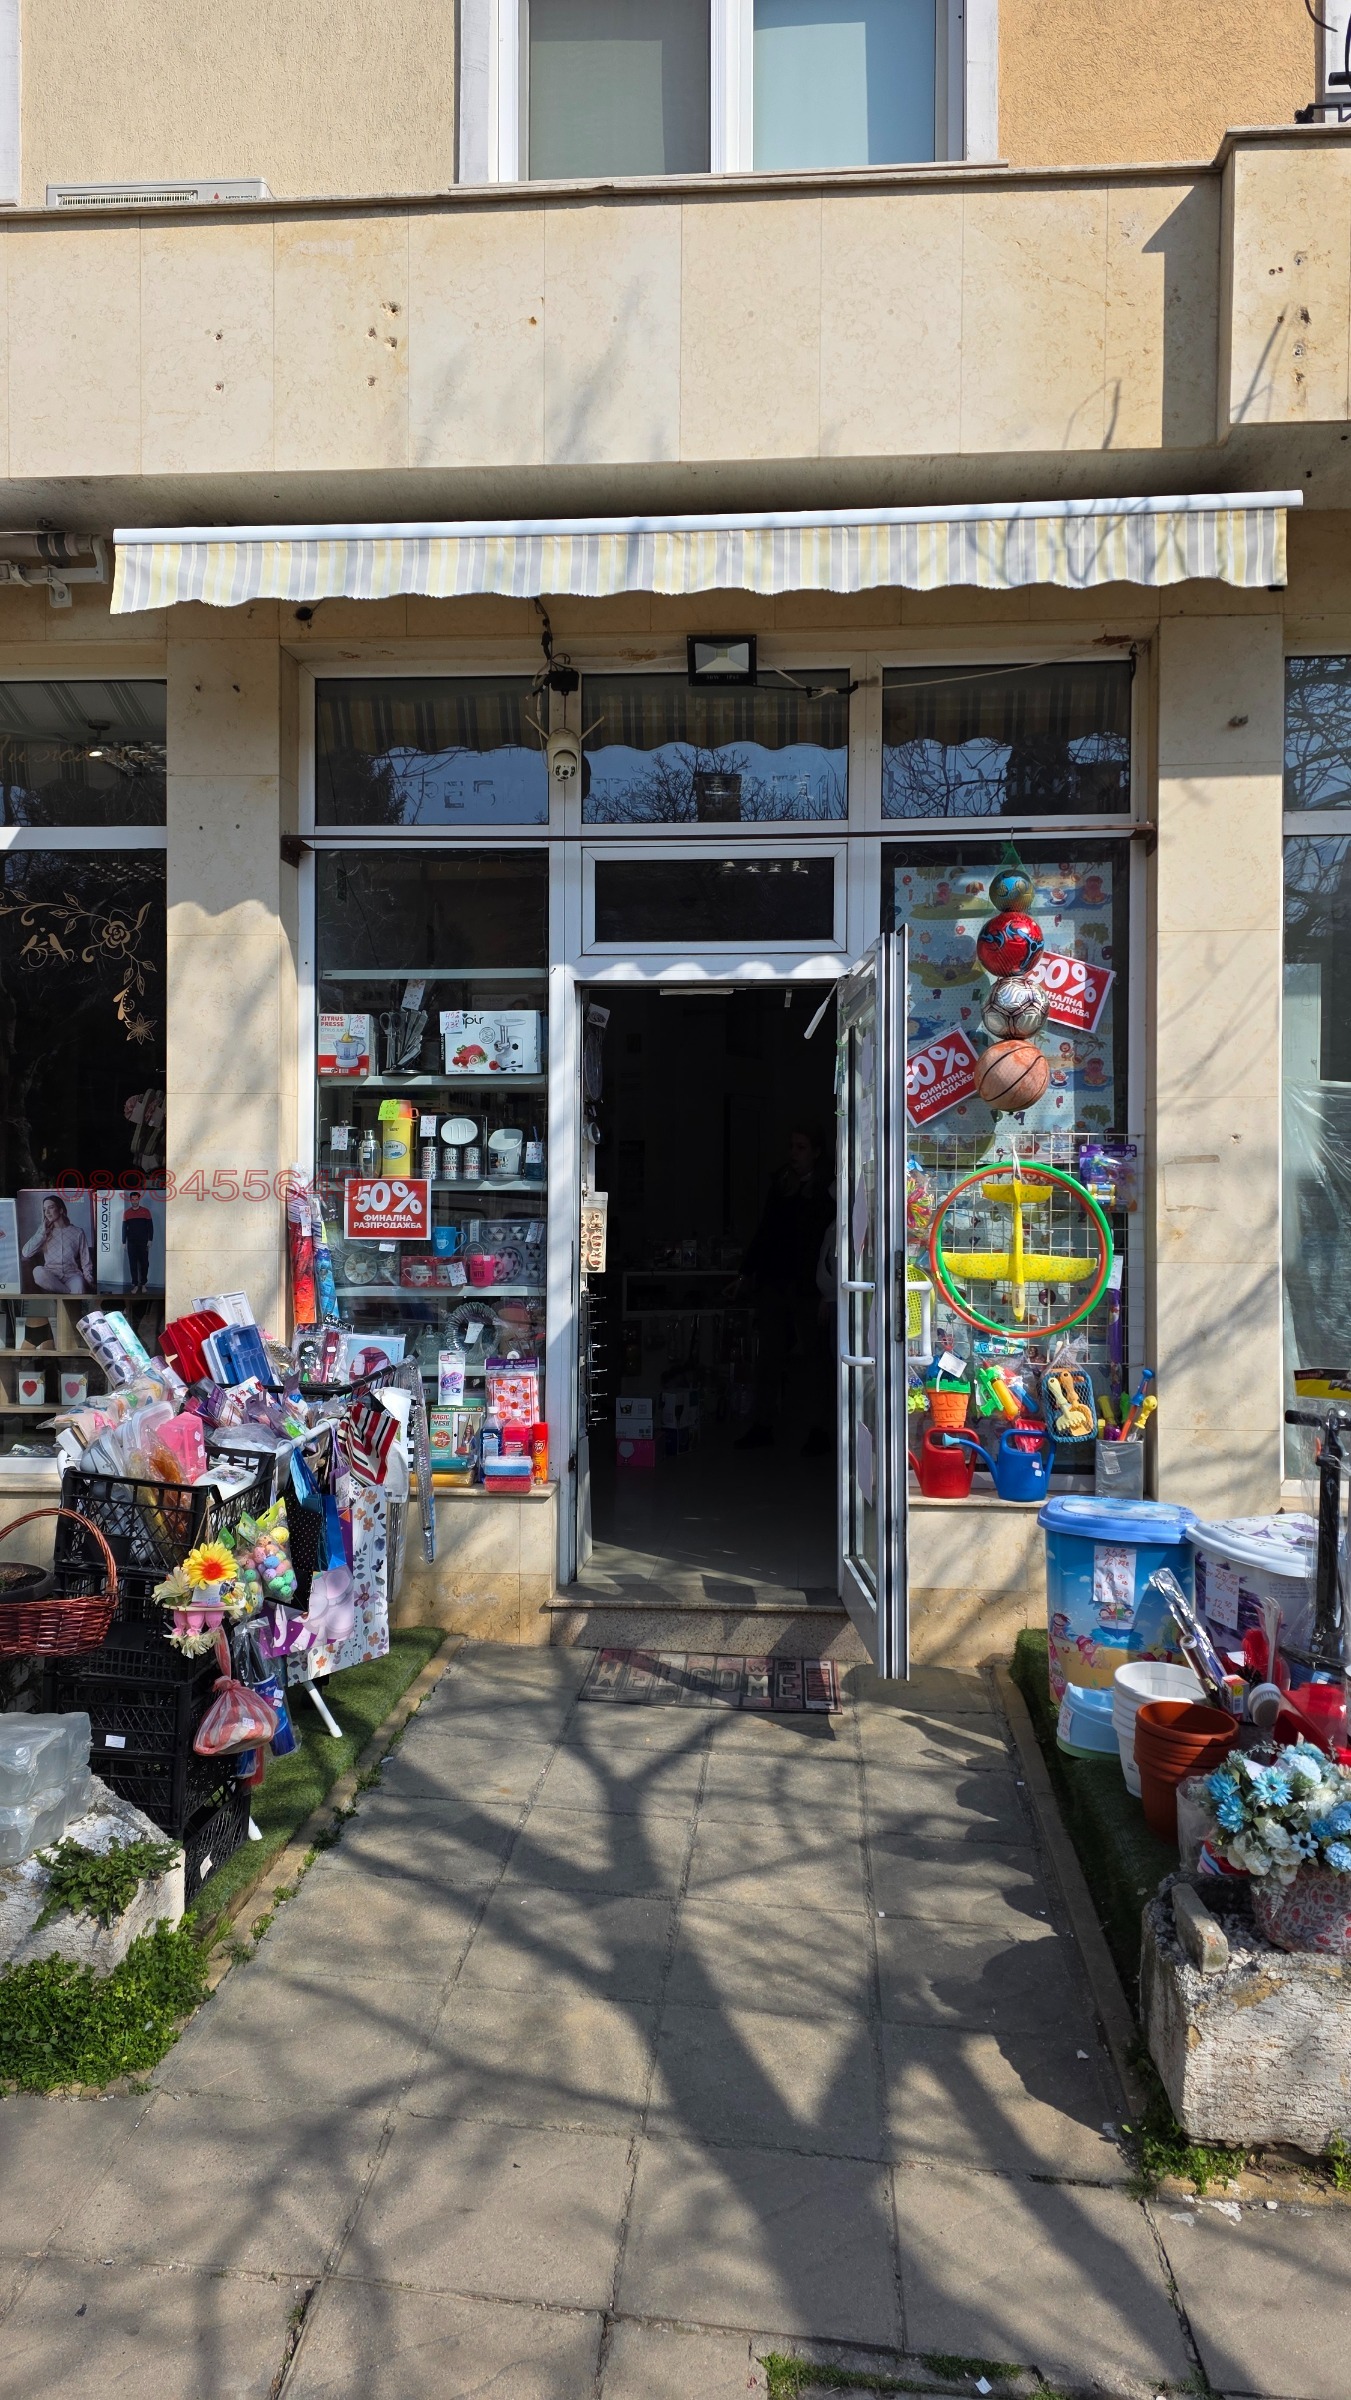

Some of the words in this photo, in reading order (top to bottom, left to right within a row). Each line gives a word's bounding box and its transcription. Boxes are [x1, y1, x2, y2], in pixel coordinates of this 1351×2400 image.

[919, 1069, 967, 1100] ФИНАЛНА
[353, 1221, 422, 1229] РАЗПРОДАЖБА
[363, 1214, 413, 1222] ФИНАЛНА
[596, 1660, 799, 1699] WELCOME
